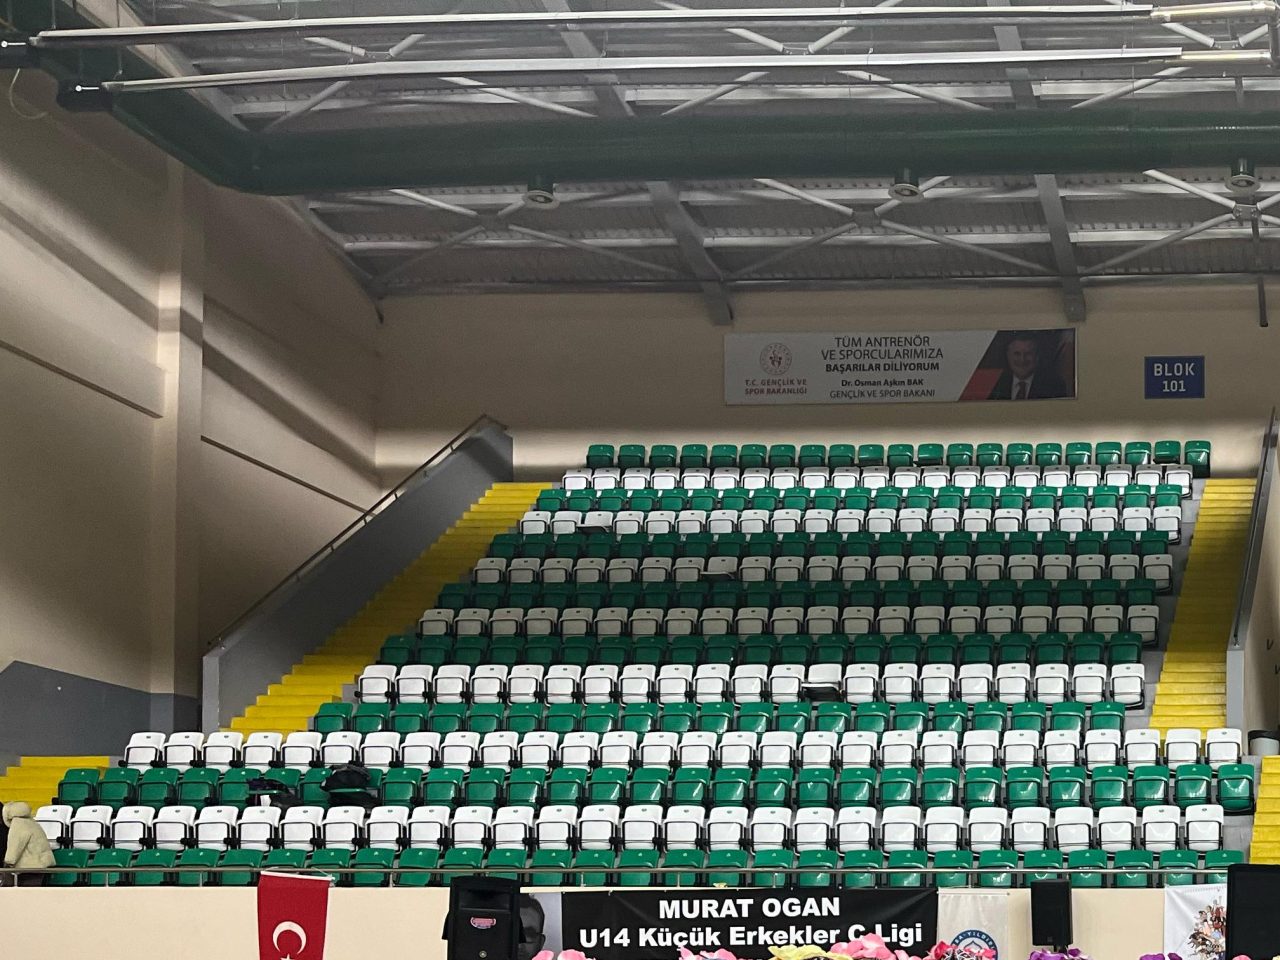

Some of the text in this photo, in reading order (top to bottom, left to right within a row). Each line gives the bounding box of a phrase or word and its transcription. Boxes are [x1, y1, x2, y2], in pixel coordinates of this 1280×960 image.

[834, 334, 930, 348] TÜM ANTRENÖR
[821, 348, 944, 361] VE SPORCULARIMIZA
[825, 361, 940, 374] BAŞARILAR DİLİYORUM
[1154, 362, 1195, 376] BLOK
[745, 377, 807, 388] T.C. GENÇLİK VE
[841, 378, 924, 389] Dr. Osman Aşkın BAK
[1162, 379, 1186, 393] 101
[745, 386, 808, 396] SPOR BAKANLIĞI
[829, 388, 936, 400] GENÇLİK VE SPOR BAKANI
[659, 897, 840, 919] MURAT OGAN
[579, 928, 630, 948] U14
[638, 926, 721, 951] Küçük
[729, 925, 841, 946] Erkekler
[875, 923, 922, 947] Ligi
